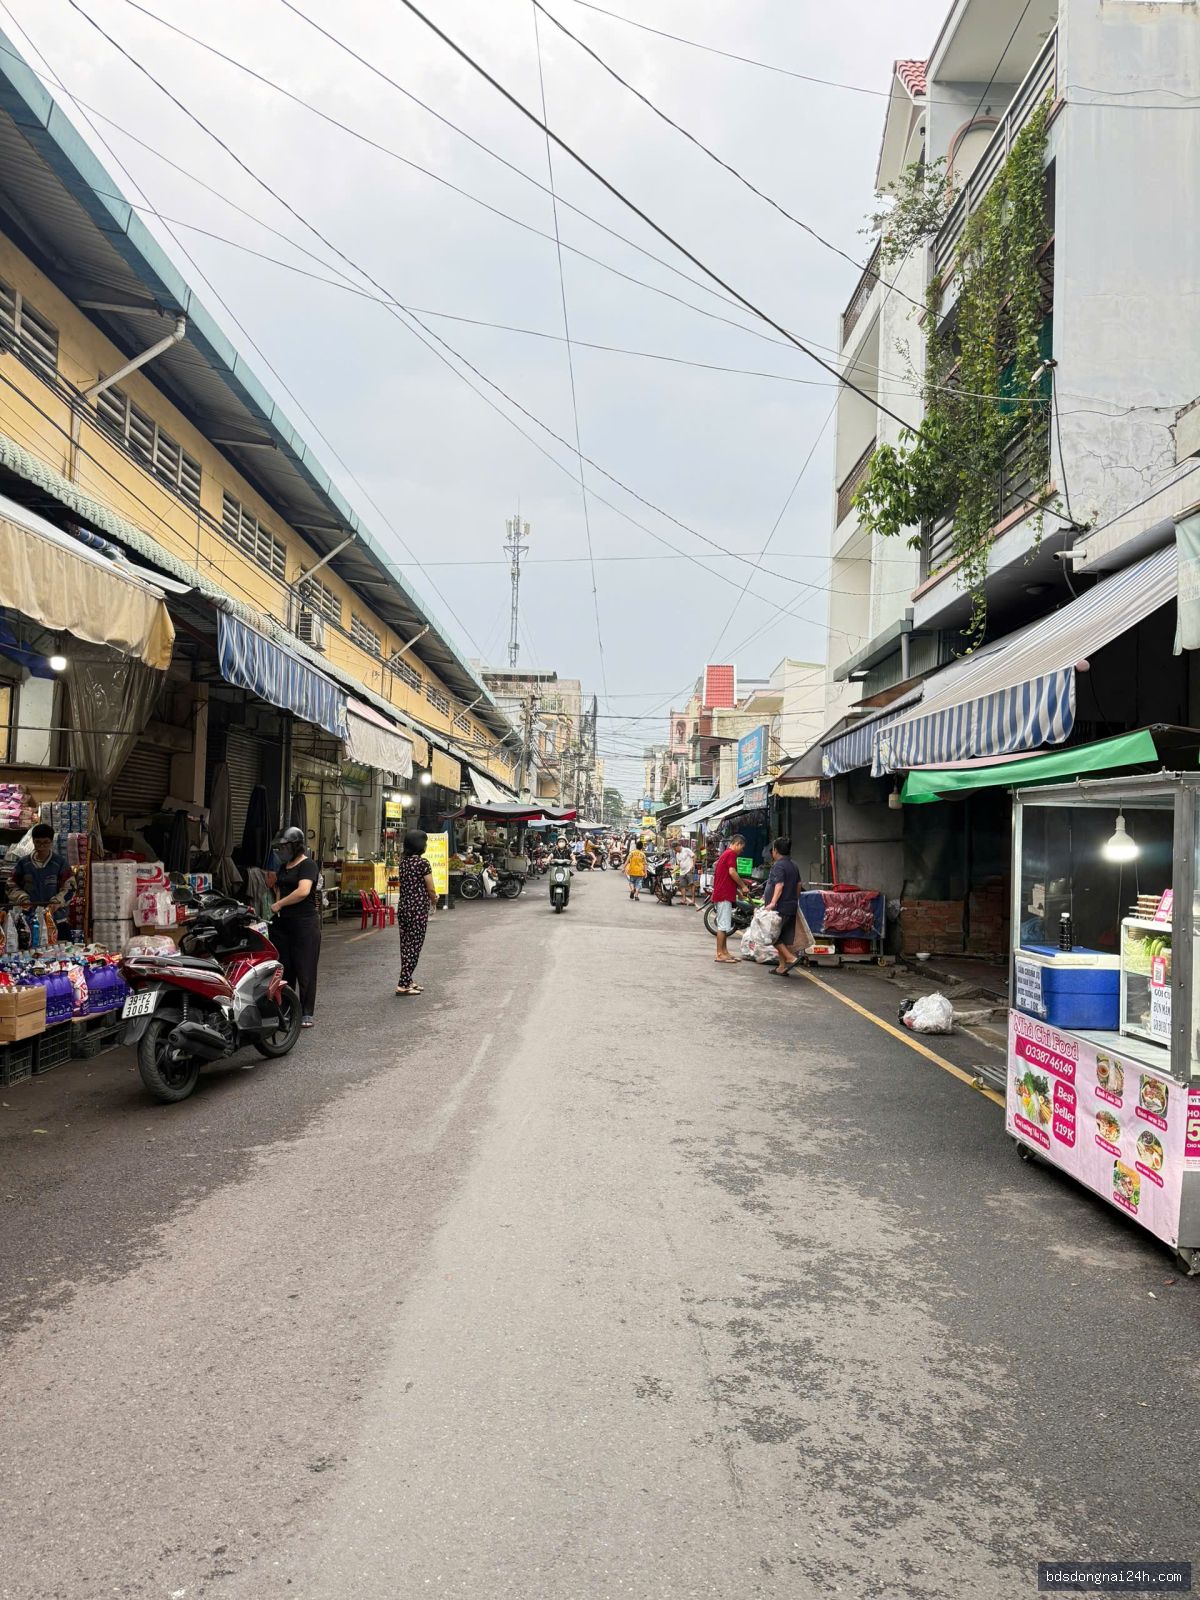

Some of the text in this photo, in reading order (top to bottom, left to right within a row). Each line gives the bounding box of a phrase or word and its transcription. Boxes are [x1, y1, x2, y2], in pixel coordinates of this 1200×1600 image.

[126, 1003, 150, 1016] 3005
[128, 993, 152, 1006] 39-F2
[1052, 1032, 1079, 1060] Food
[1025, 1044, 1074, 1076] 0338746149
[1057, 1086, 1075, 1104] Best
[1054, 1103, 1075, 1123] Seller
[1055, 1121, 1074, 1142] 119K
